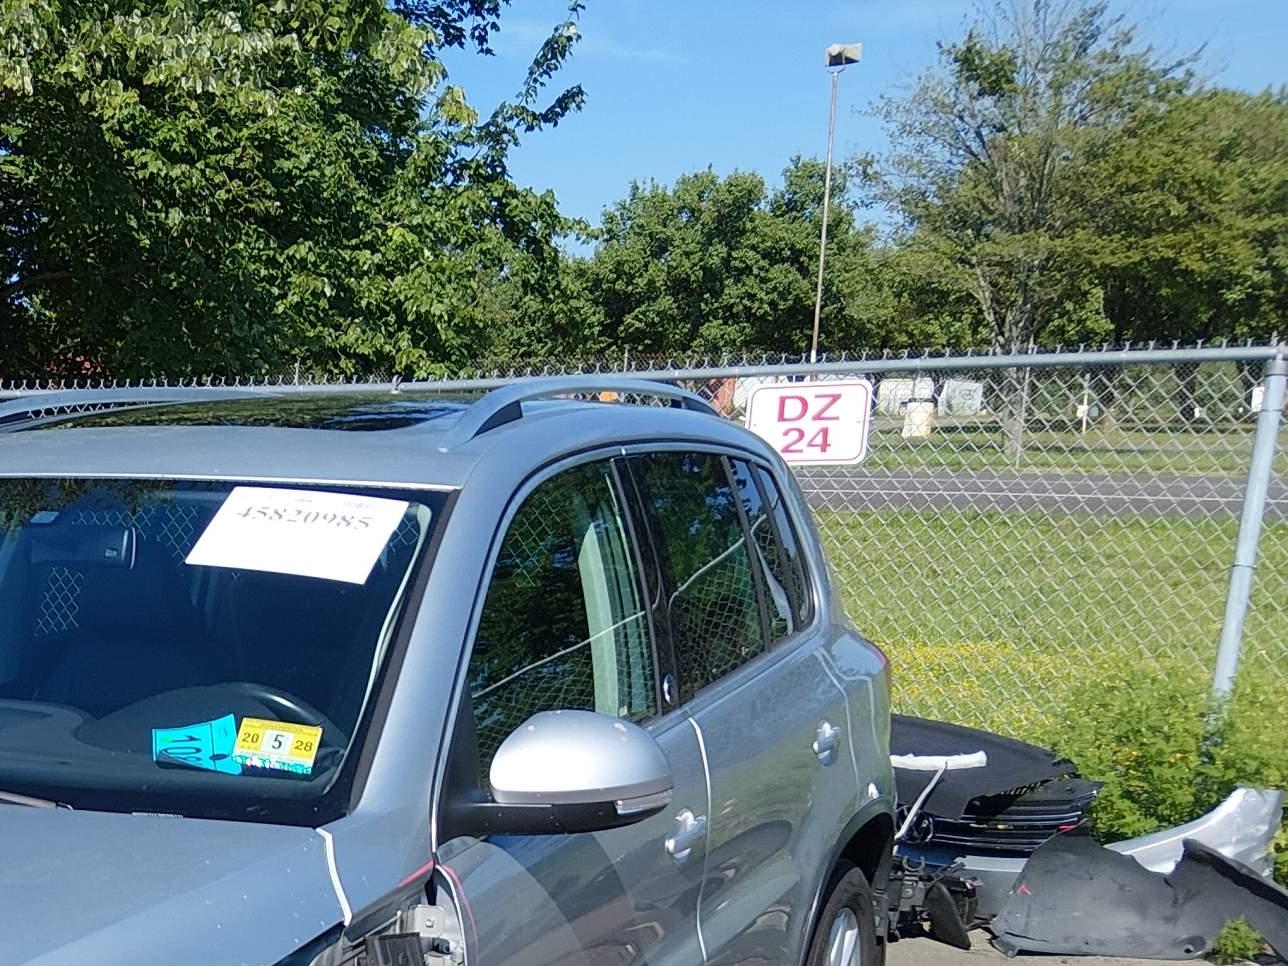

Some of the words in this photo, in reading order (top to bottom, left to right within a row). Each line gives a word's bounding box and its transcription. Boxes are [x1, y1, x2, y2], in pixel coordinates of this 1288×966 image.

[776, 393, 842, 423] DZ
[780, 426, 832, 454] 24
[235, 505, 372, 529] 45820985
[241, 731, 260, 744] 20
[271, 732, 285, 750] 5
[293, 738, 314, 752] 28
